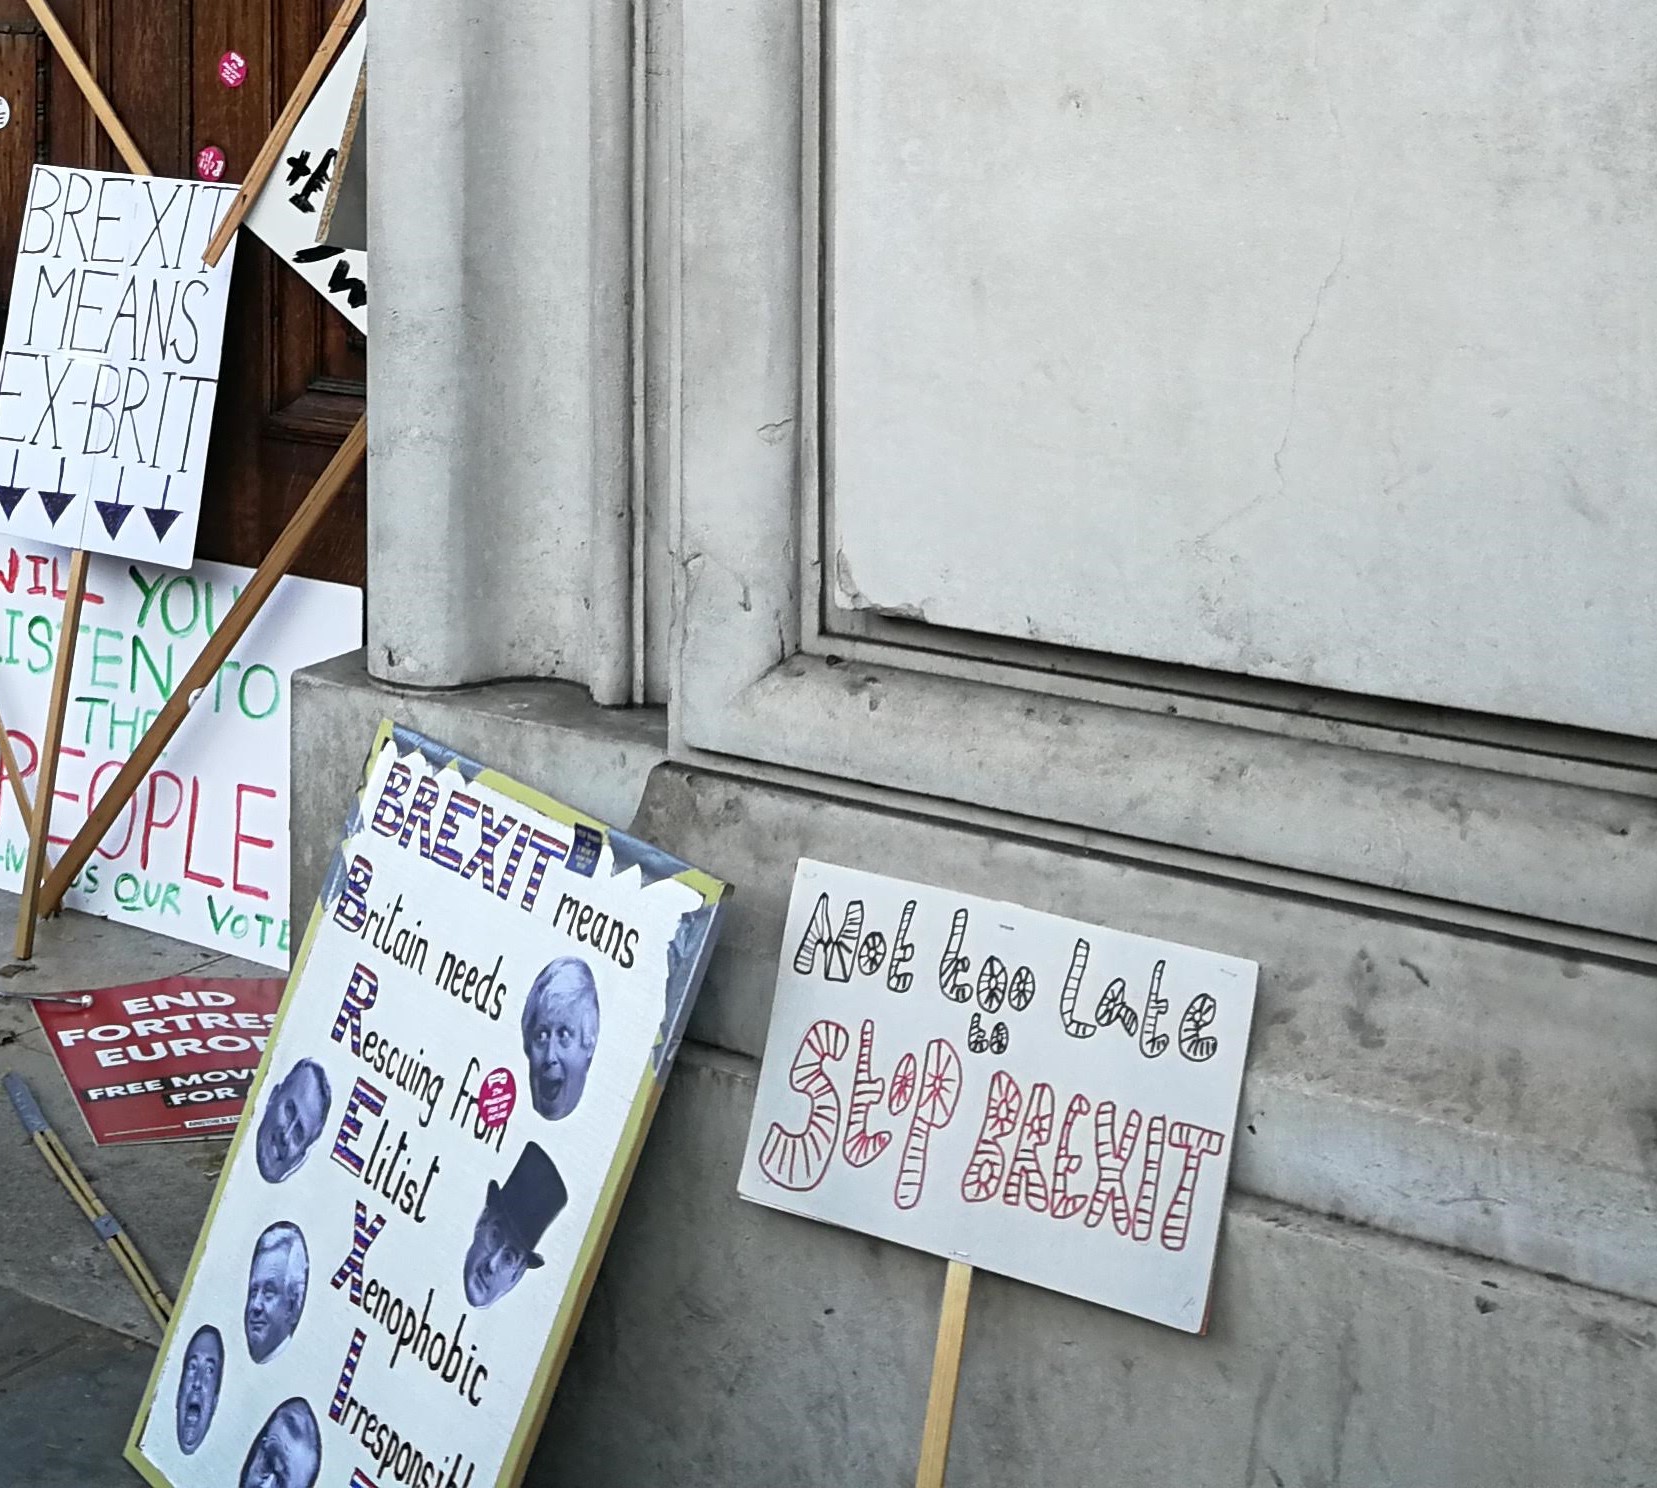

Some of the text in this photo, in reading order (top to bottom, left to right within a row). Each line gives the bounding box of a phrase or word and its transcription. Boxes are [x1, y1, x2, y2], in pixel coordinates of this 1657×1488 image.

[20, 168, 242, 274] BREXIT
[23, 266, 210, 365] MEANS
[129, 565, 241, 640] YOU
[216, 661, 281, 720] TO
[114, 872, 182, 915] OUR
[208, 894, 291, 951] VOTE
[371, 762, 639, 969] BREXIT means
[333, 854, 507, 1021] Britain needs
[794, 892, 917, 993] Not
[939, 908, 1036, 1014] too
[57, 1013, 278, 1047] FORTRES
[94, 1035, 269, 1068] EUROP
[122, 991, 236, 1015] END
[330, 962, 444, 1127] Rescuing
[967, 1012, 1009, 1054] to
[87, 1068, 258, 1101] FREE MOV
[169, 1087, 239, 1105] FOR
[330, 1076, 440, 1224] Elitist
[961, 1069, 1225, 1252] BREXIT
[330, 1199, 489, 1407] Xenophobic
[328, 1327, 476, 1487] Irresponsibl
